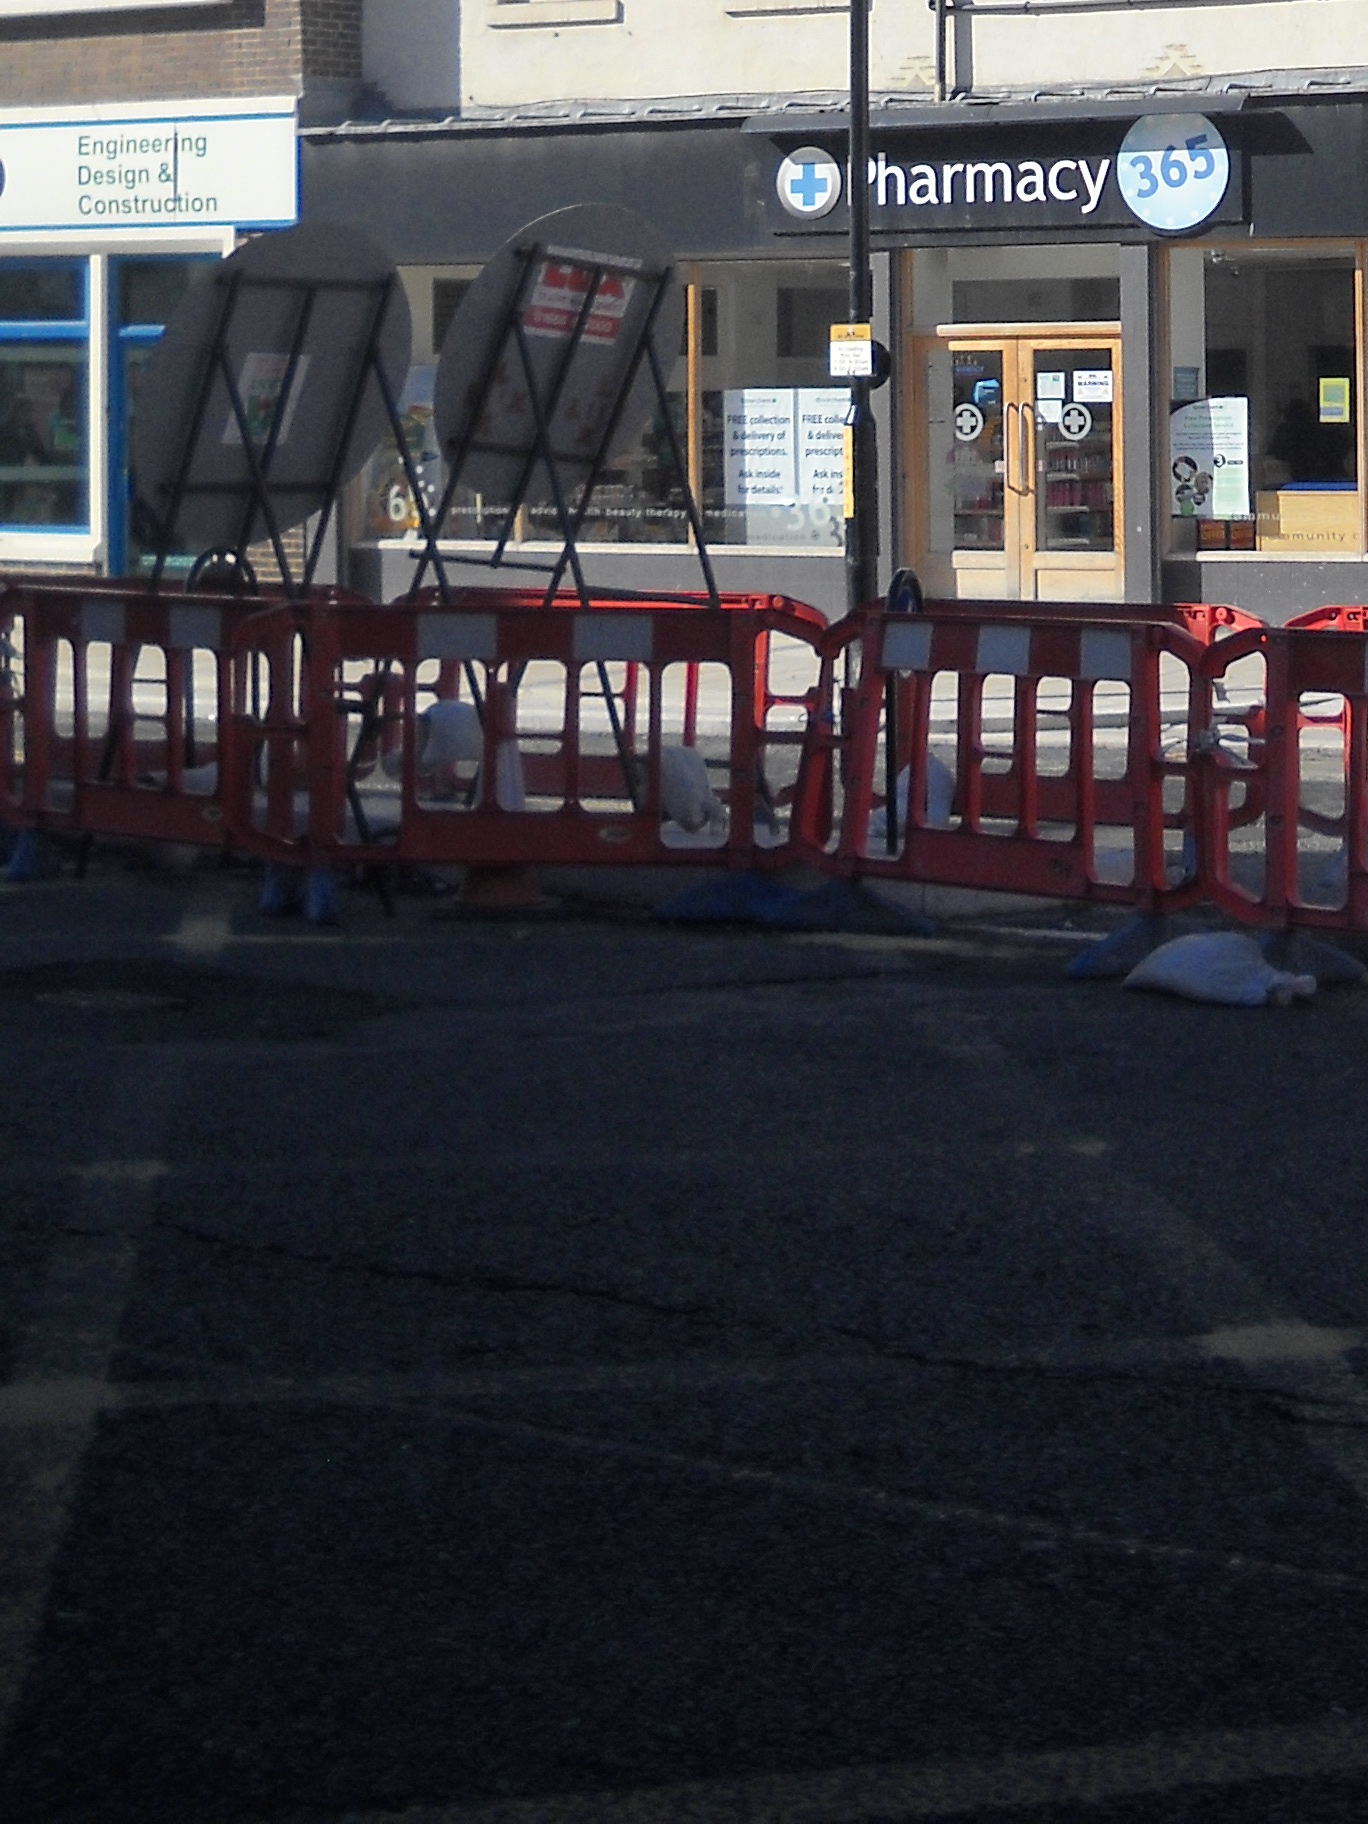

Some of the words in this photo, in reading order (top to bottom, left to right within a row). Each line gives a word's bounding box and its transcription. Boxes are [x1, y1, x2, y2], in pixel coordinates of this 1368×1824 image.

[78, 133, 208, 160] Engineering
[1129, 133, 1216, 200] 365
[78, 165, 150, 189] Design
[158, 163, 174, 183] &
[79, 192, 218, 215] Construction
[728, 414, 747, 424] FREE
[749, 415, 791, 424] collection
[802, 414, 823, 424] FREE
[741, 430, 775, 442] delivery
[777, 430, 786, 440] of
[739, 469, 753, 479] Ask
[756, 470, 781, 479] inside
[813, 469, 828, 478] Ask
[605, 507, 642, 519] beauty
[645, 506, 687, 519] therapy
